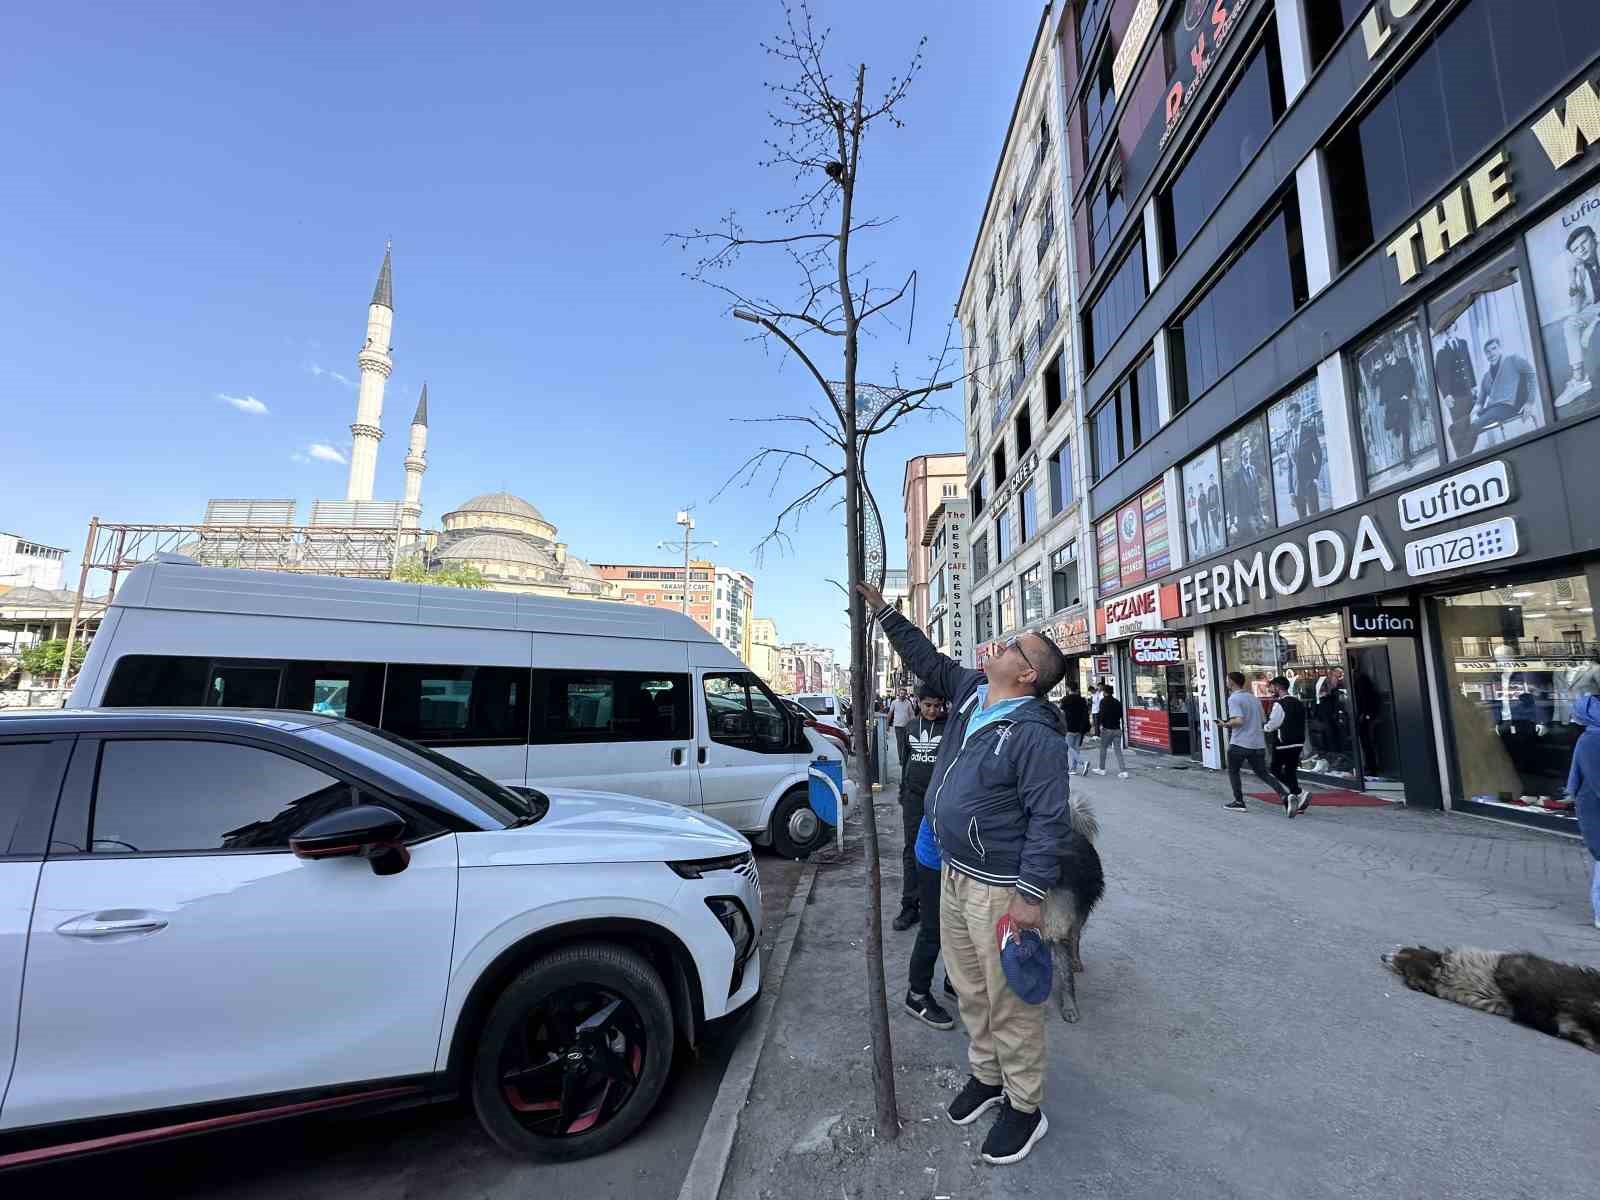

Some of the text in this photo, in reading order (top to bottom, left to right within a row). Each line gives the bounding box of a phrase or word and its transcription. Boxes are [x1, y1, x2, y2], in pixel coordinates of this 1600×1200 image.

[1386, 151, 1515, 285] THE
[1011, 462, 1029, 490] CAFE
[947, 511, 966, 519] The
[1402, 476, 1504, 525] Lufian
[951, 524, 961, 559] BEST
[1415, 535, 1475, 570] imza
[947, 562, 967, 570] CAFE
[1180, 515, 1394, 617] FERMODA
[1106, 590, 1156, 624] ECZANE
[1352, 614, 1414, 630] Lufian
[1135, 638, 1179, 650] ECZANE
[1136, 648, 1180, 662] GÜNDÜZ
[1098, 660, 1109, 672] E
[1198, 651, 1211, 749] ECZANE
